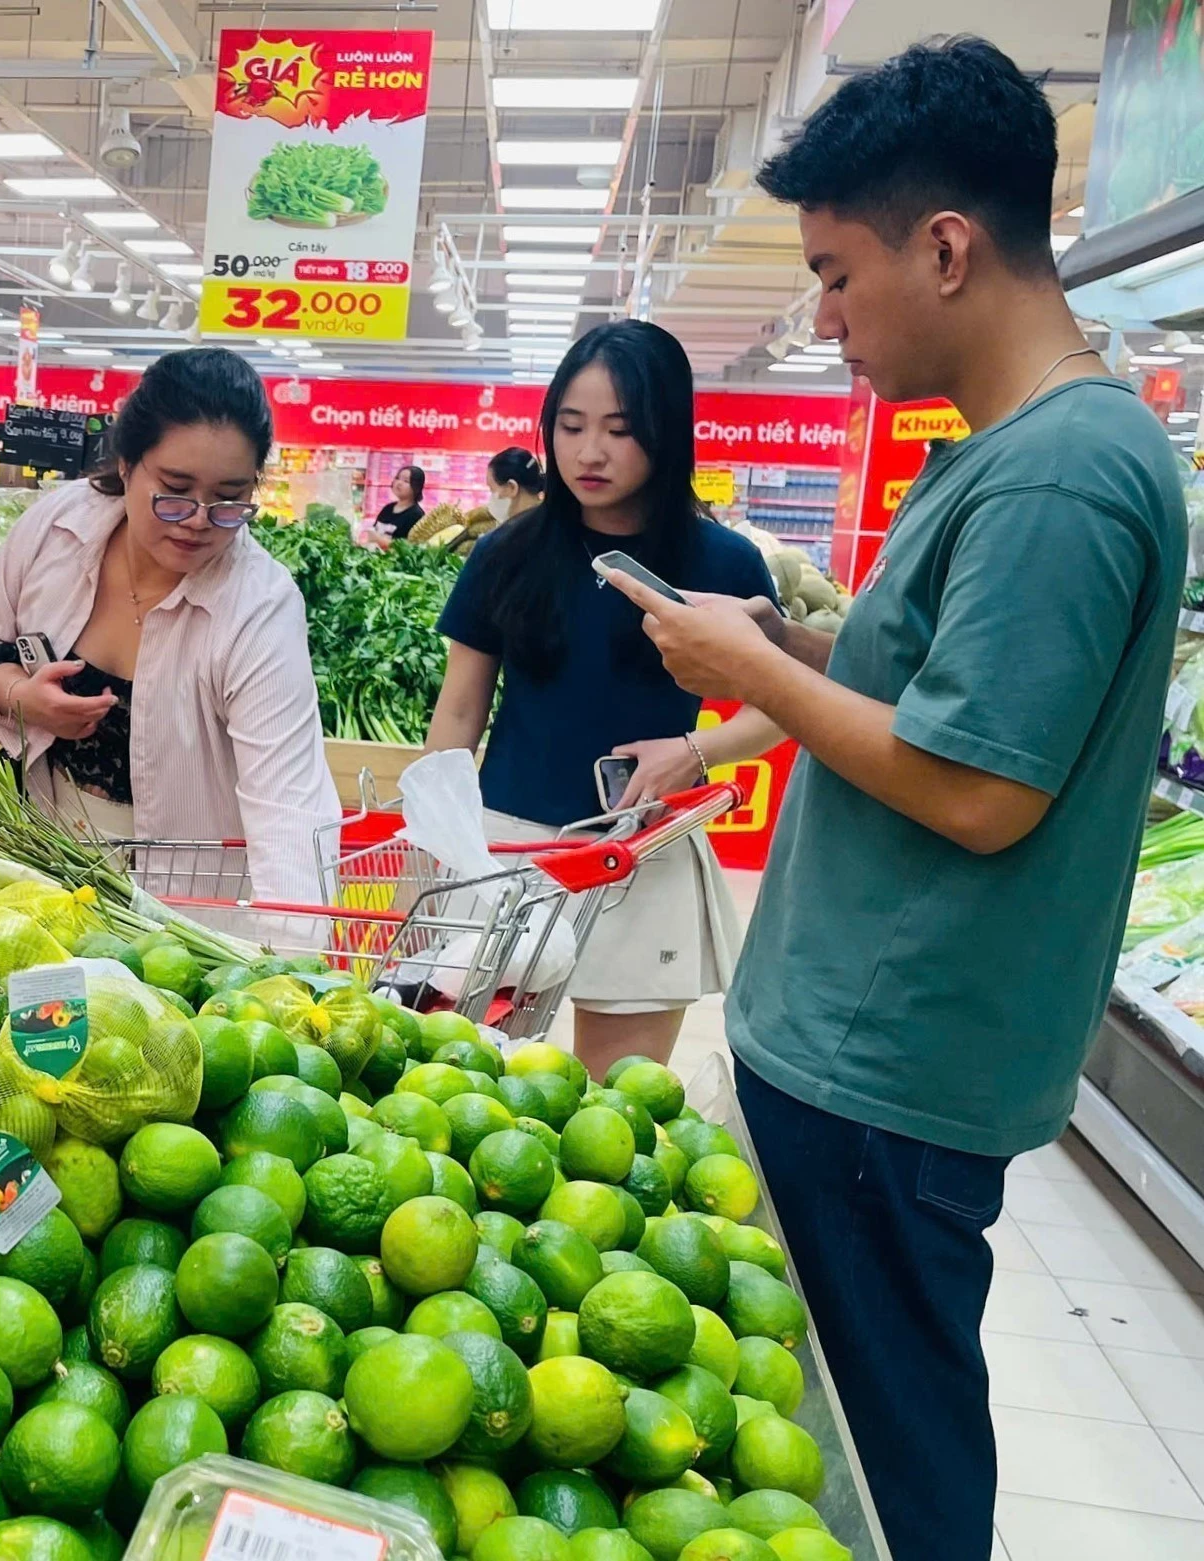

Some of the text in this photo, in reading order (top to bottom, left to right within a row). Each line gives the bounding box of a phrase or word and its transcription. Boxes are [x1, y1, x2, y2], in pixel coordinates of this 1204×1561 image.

[336, 51, 413, 63] LUÔN LUÔN
[244, 56, 305, 88] GIÁ
[334, 65, 423, 89] RẺ HƠN
[304, 317, 365, 334] vnd/kg
[311, 405, 365, 430] Chọn
[369, 405, 404, 428] tiết
[408, 408, 459, 434] kiệm
[476, 412, 532, 437] Chọn
[694, 420, 752, 447] Chọn
[757, 419, 795, 444] tiết
